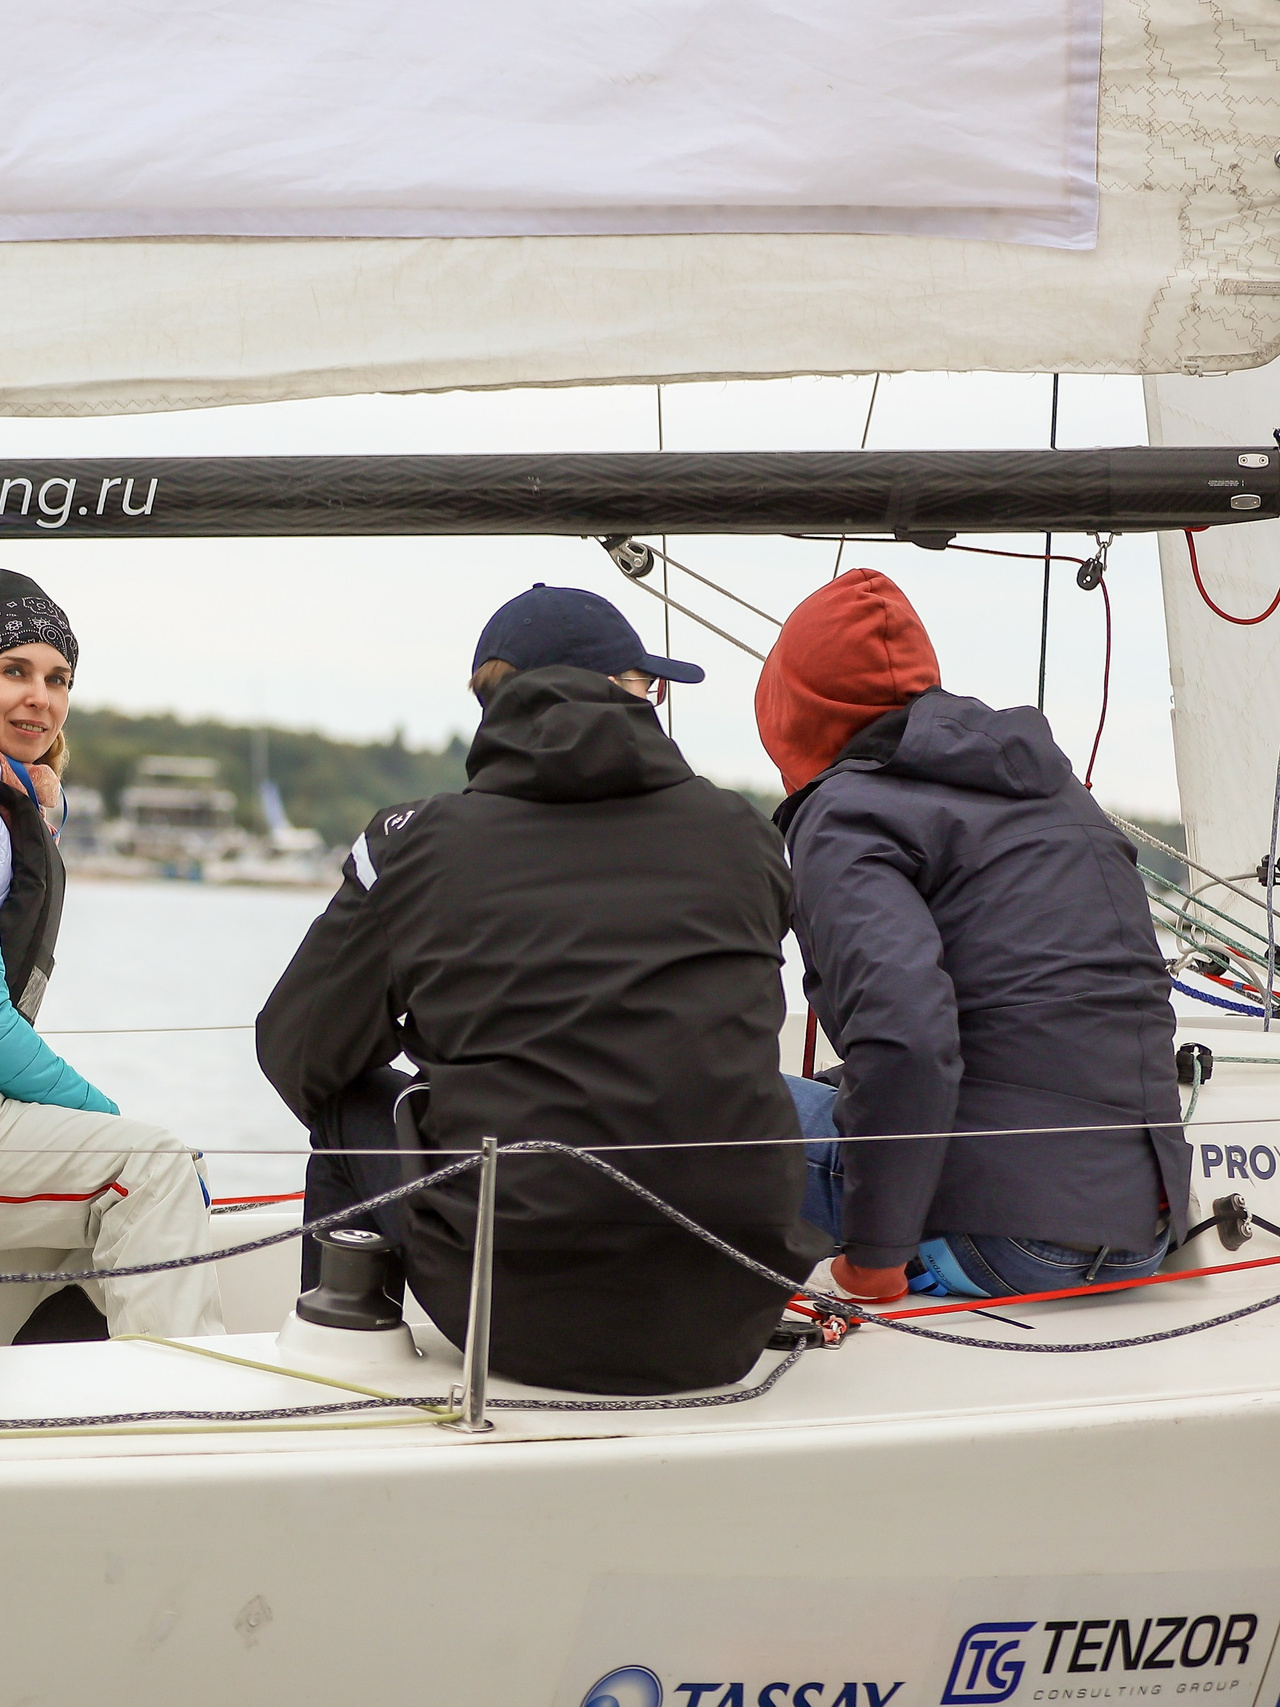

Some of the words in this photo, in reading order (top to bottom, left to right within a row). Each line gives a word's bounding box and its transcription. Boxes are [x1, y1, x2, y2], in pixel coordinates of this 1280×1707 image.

[1200, 1144, 1280, 1181] PRO
[1042, 1613, 1258, 1674] TENZOR
[1032, 1684, 1163, 1701] CONSULTING
[1175, 1680, 1240, 1694] GROUP
